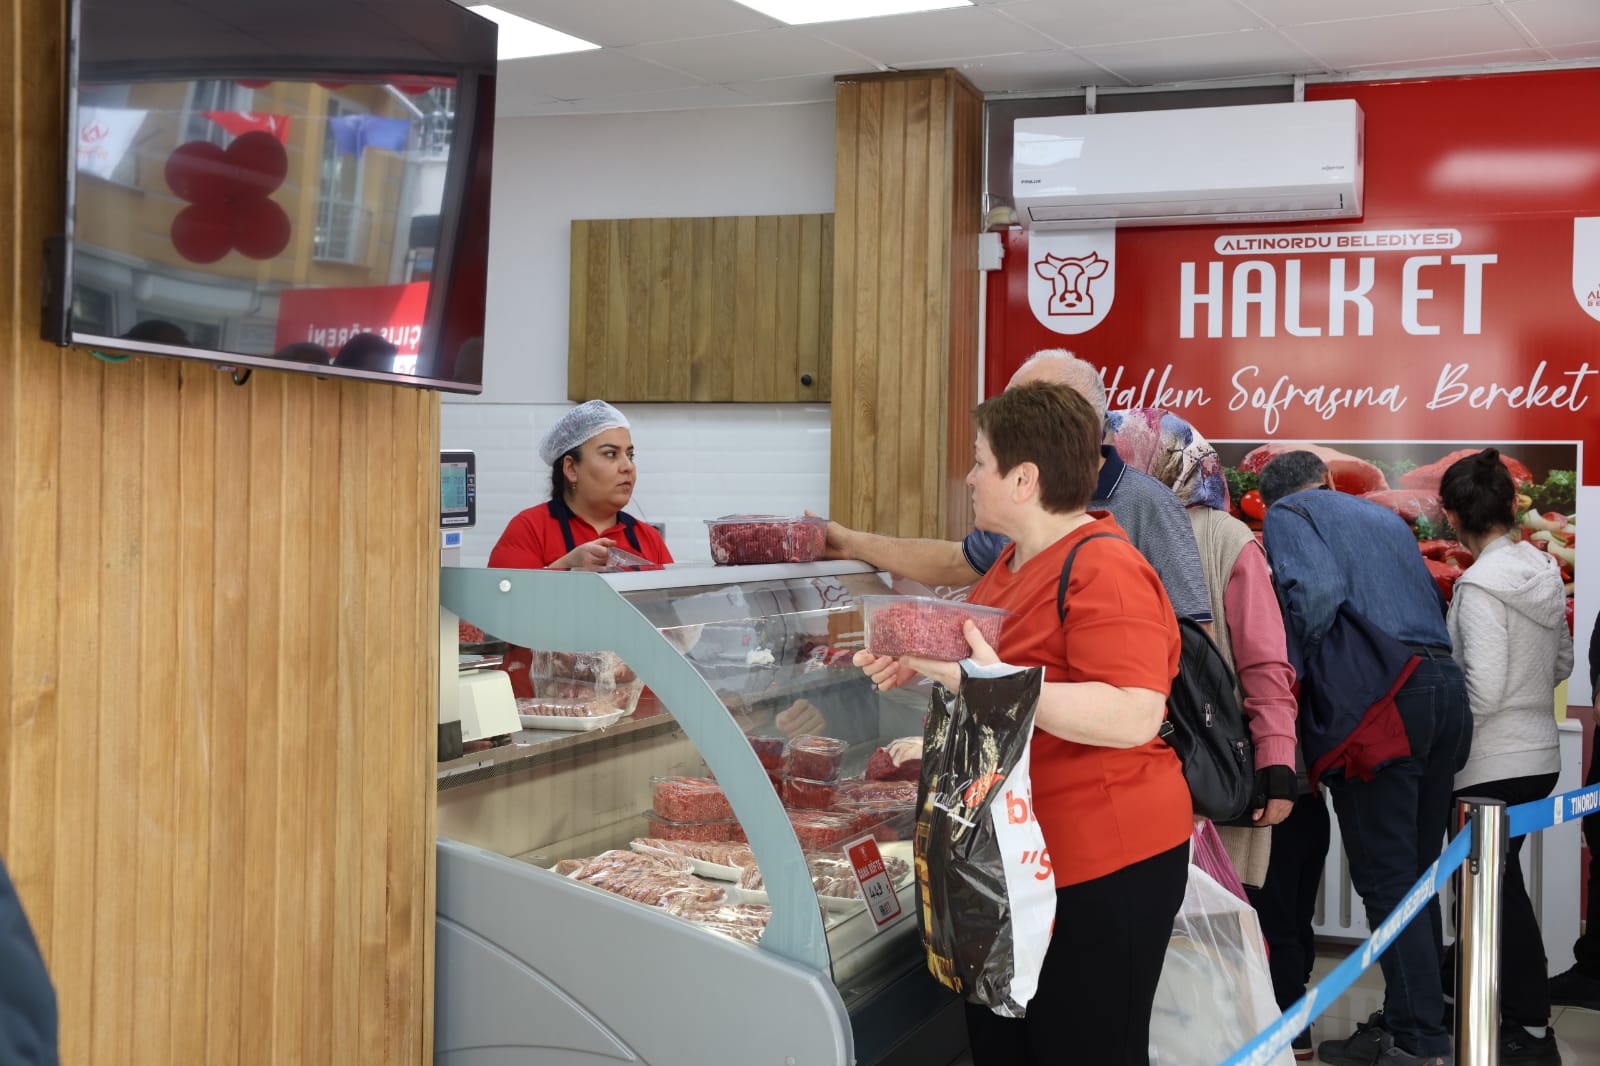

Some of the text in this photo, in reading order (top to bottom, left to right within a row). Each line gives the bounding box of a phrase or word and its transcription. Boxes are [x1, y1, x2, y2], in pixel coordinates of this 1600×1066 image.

[1222, 232, 1454, 251] ALTINORDU BELEDİYESİ
[1180, 253, 1498, 339] HALK ET
[1100, 360, 1600, 435] Halkın Sofrasına Bereket
